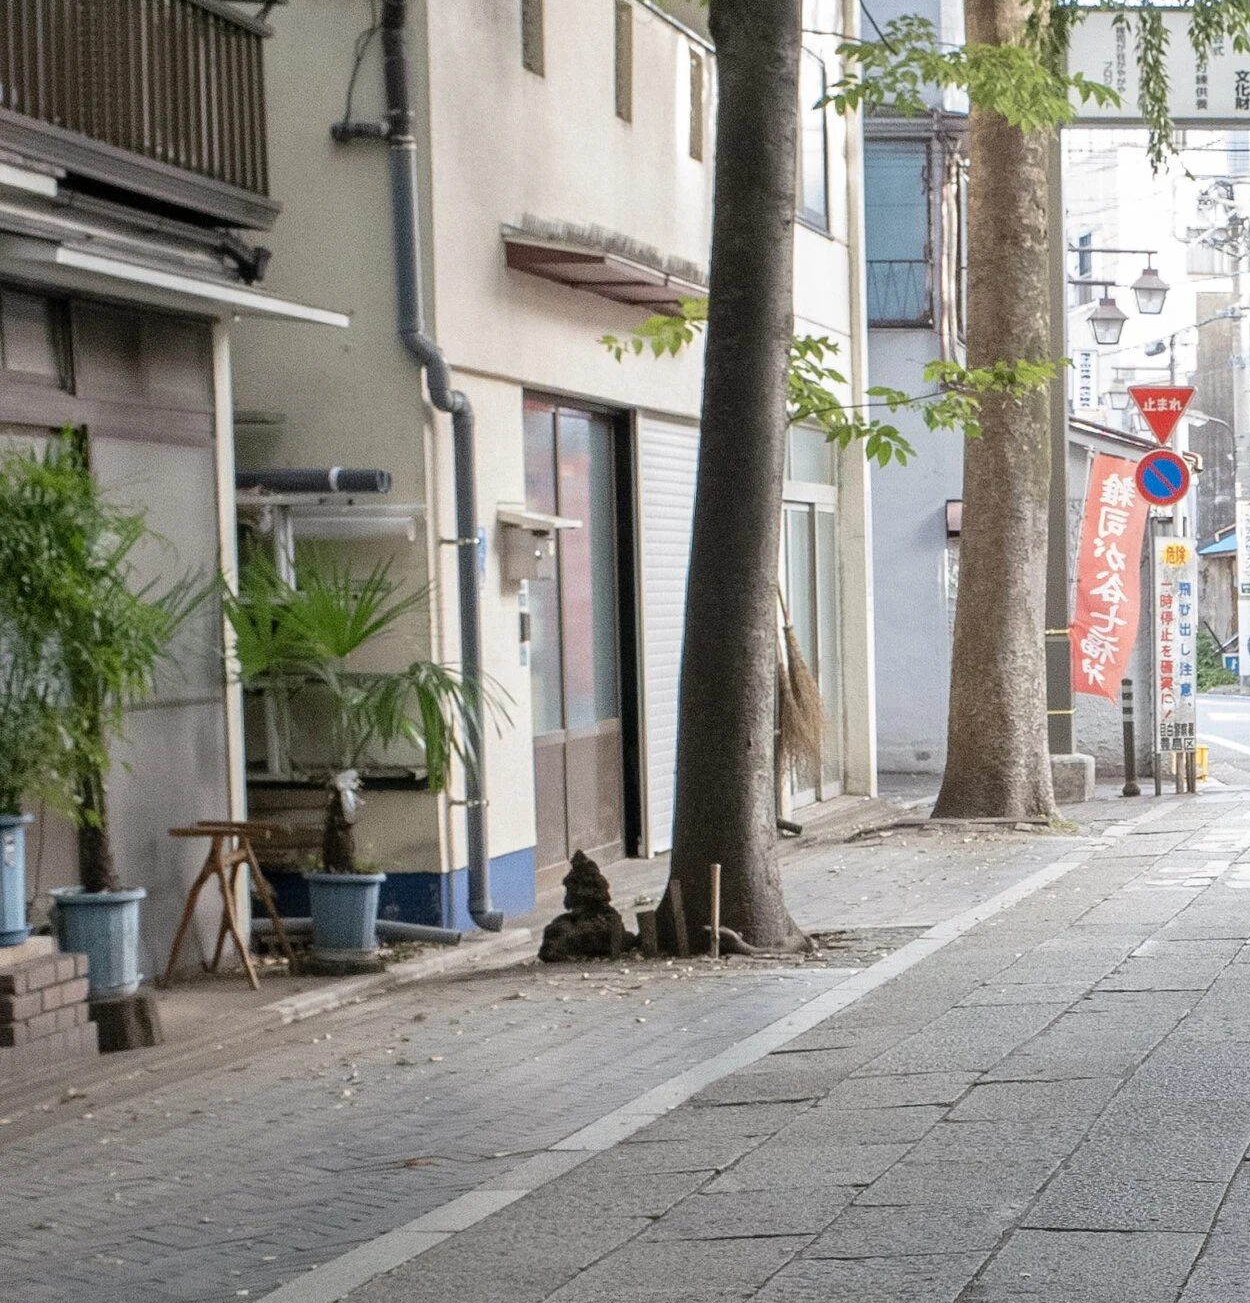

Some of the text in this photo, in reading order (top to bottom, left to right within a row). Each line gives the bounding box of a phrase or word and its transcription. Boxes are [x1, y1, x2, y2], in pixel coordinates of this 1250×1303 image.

[1195, 52, 1208, 110] 灯練供養
[1235, 70, 1249, 110] 文化財
[1142, 397, 1182, 412] 止まれ
[1166, 545, 1186, 564] 危険
[1160, 722, 1194, 737] 目白警察署
[1160, 737, 1196, 751] 豊島区
